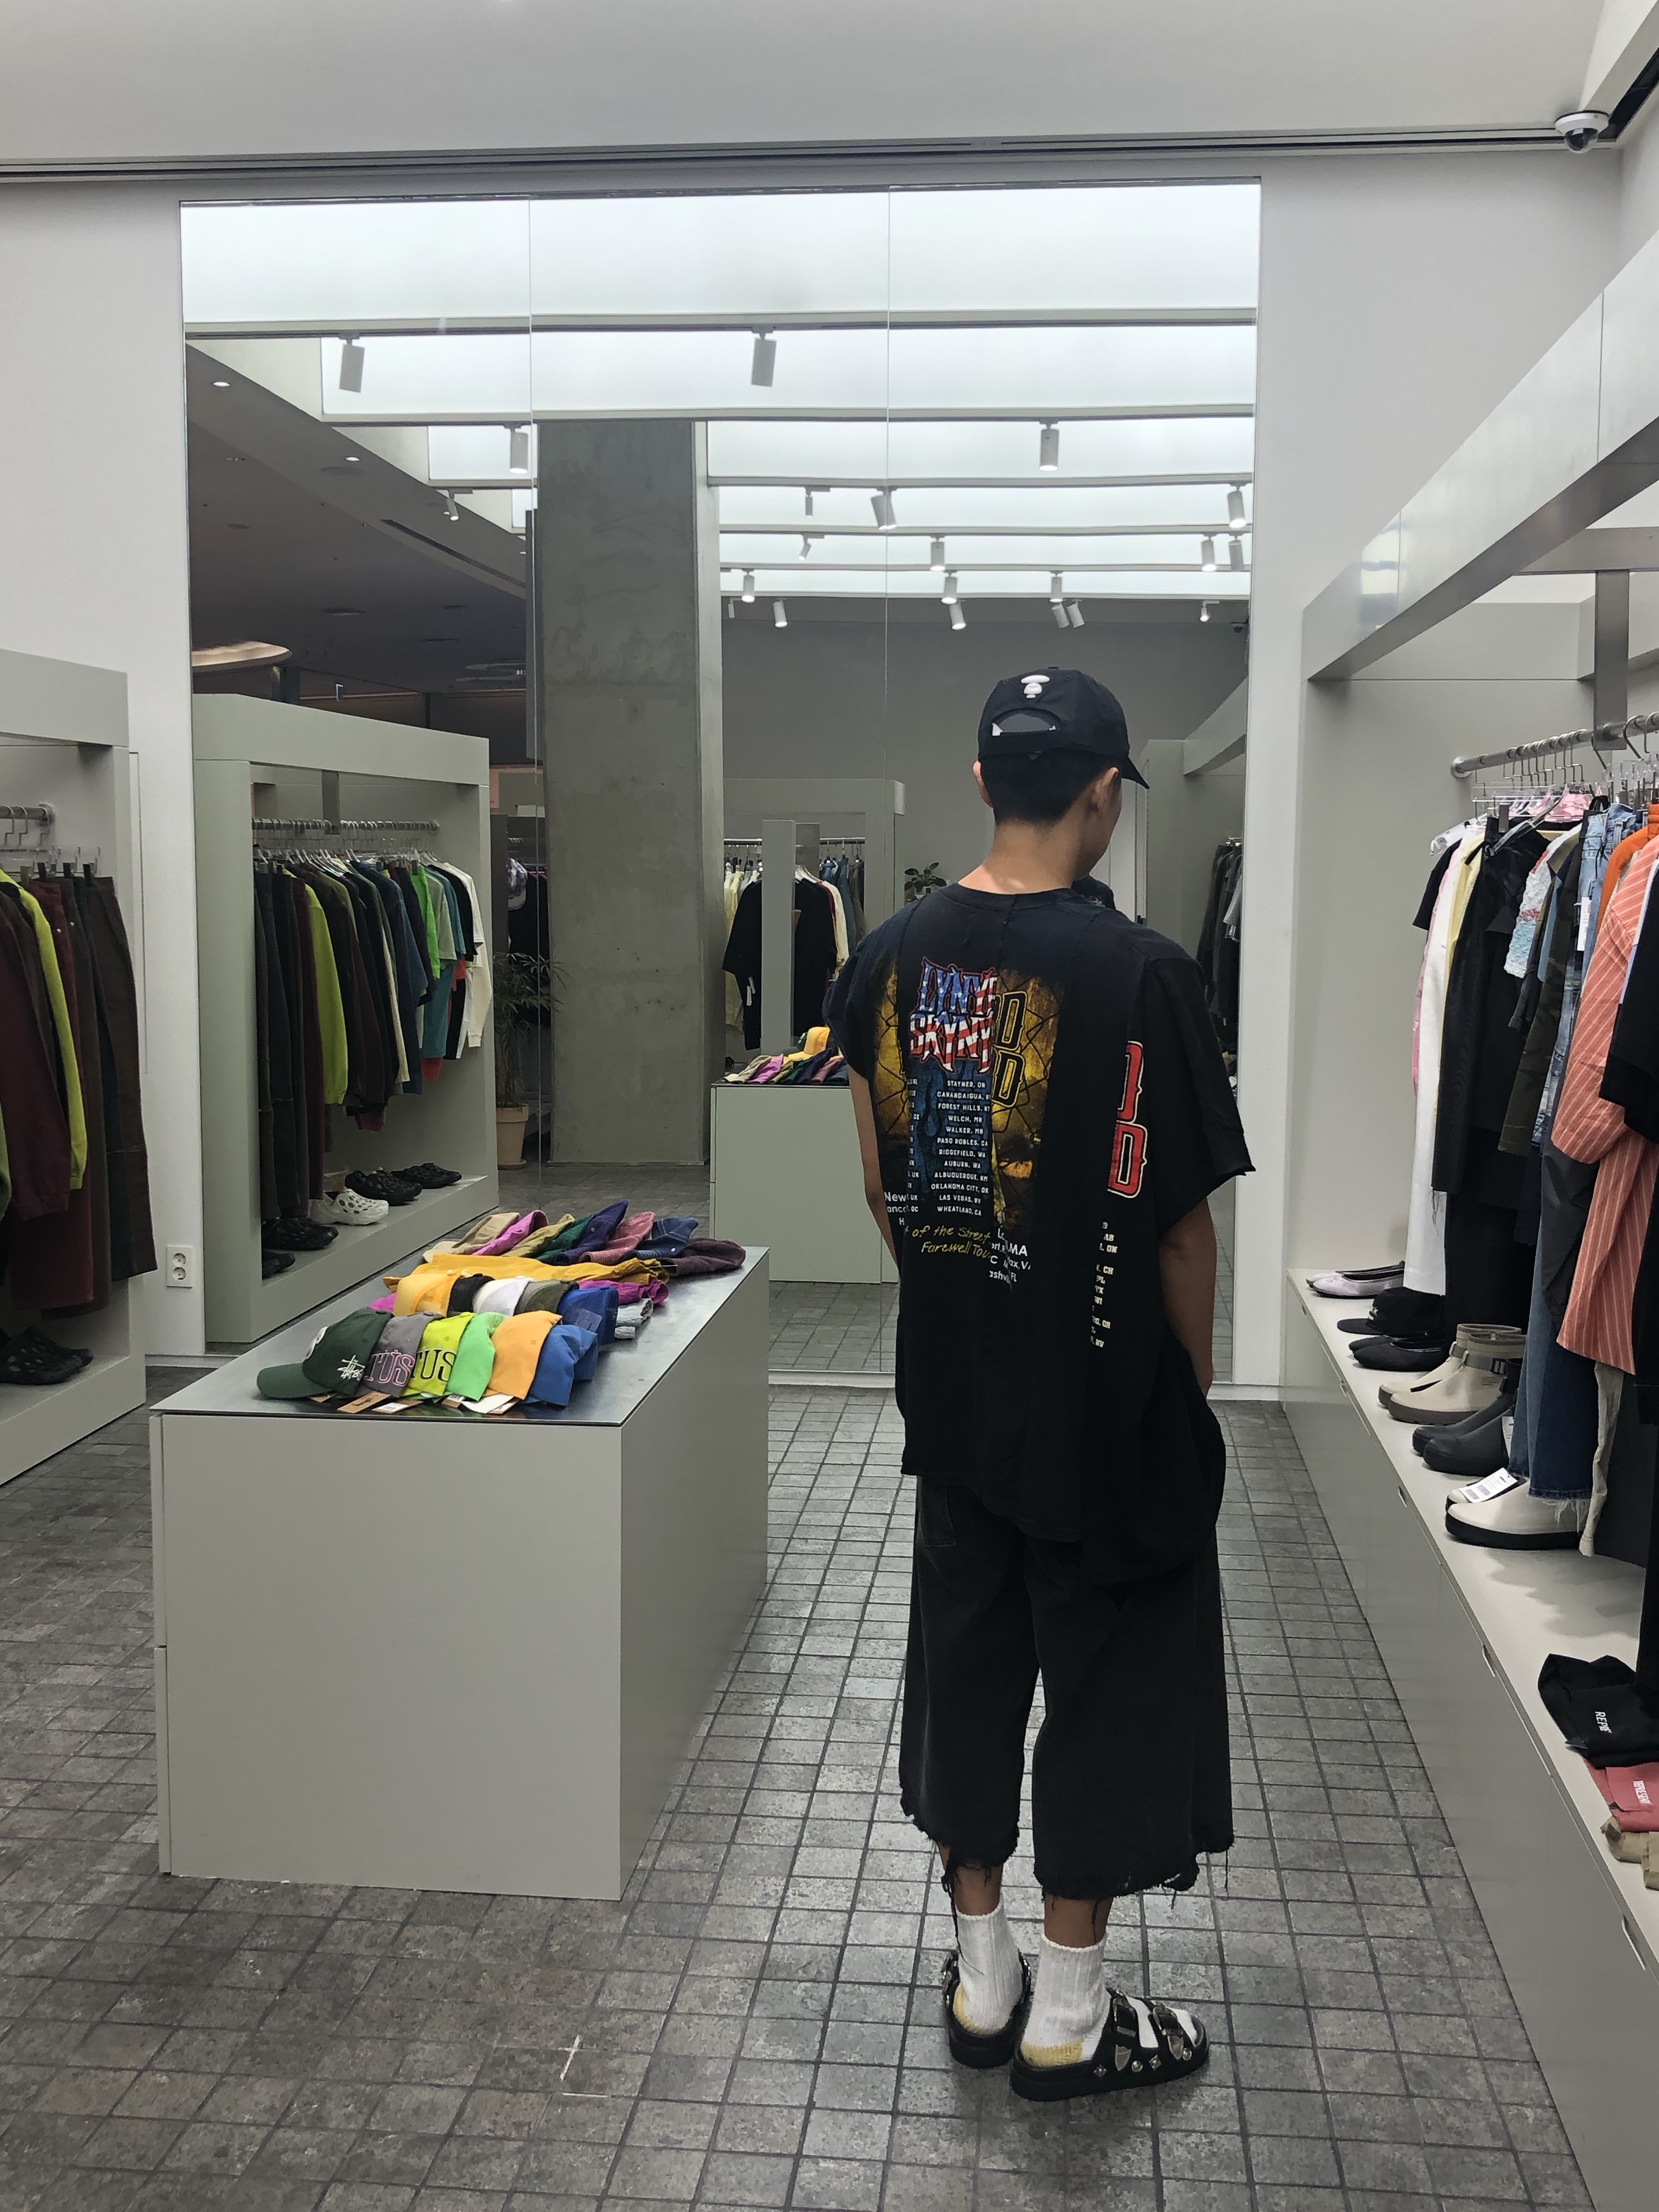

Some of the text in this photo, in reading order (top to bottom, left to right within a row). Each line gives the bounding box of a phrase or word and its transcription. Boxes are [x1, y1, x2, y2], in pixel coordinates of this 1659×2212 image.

[947, 1080, 975, 1088] STAYNER,
[948, 1115, 972, 1123] WELCH,
[945, 1126, 973, 1135] WALKER,
[939, 1149, 976, 1158] RIDGEFIELD,
[944, 1160, 970, 1169] AUBURN,
[937, 1206, 974, 1215] WHEATLAND,
[912, 1225, 930, 1238] of
[933, 1225, 954, 1237] the
